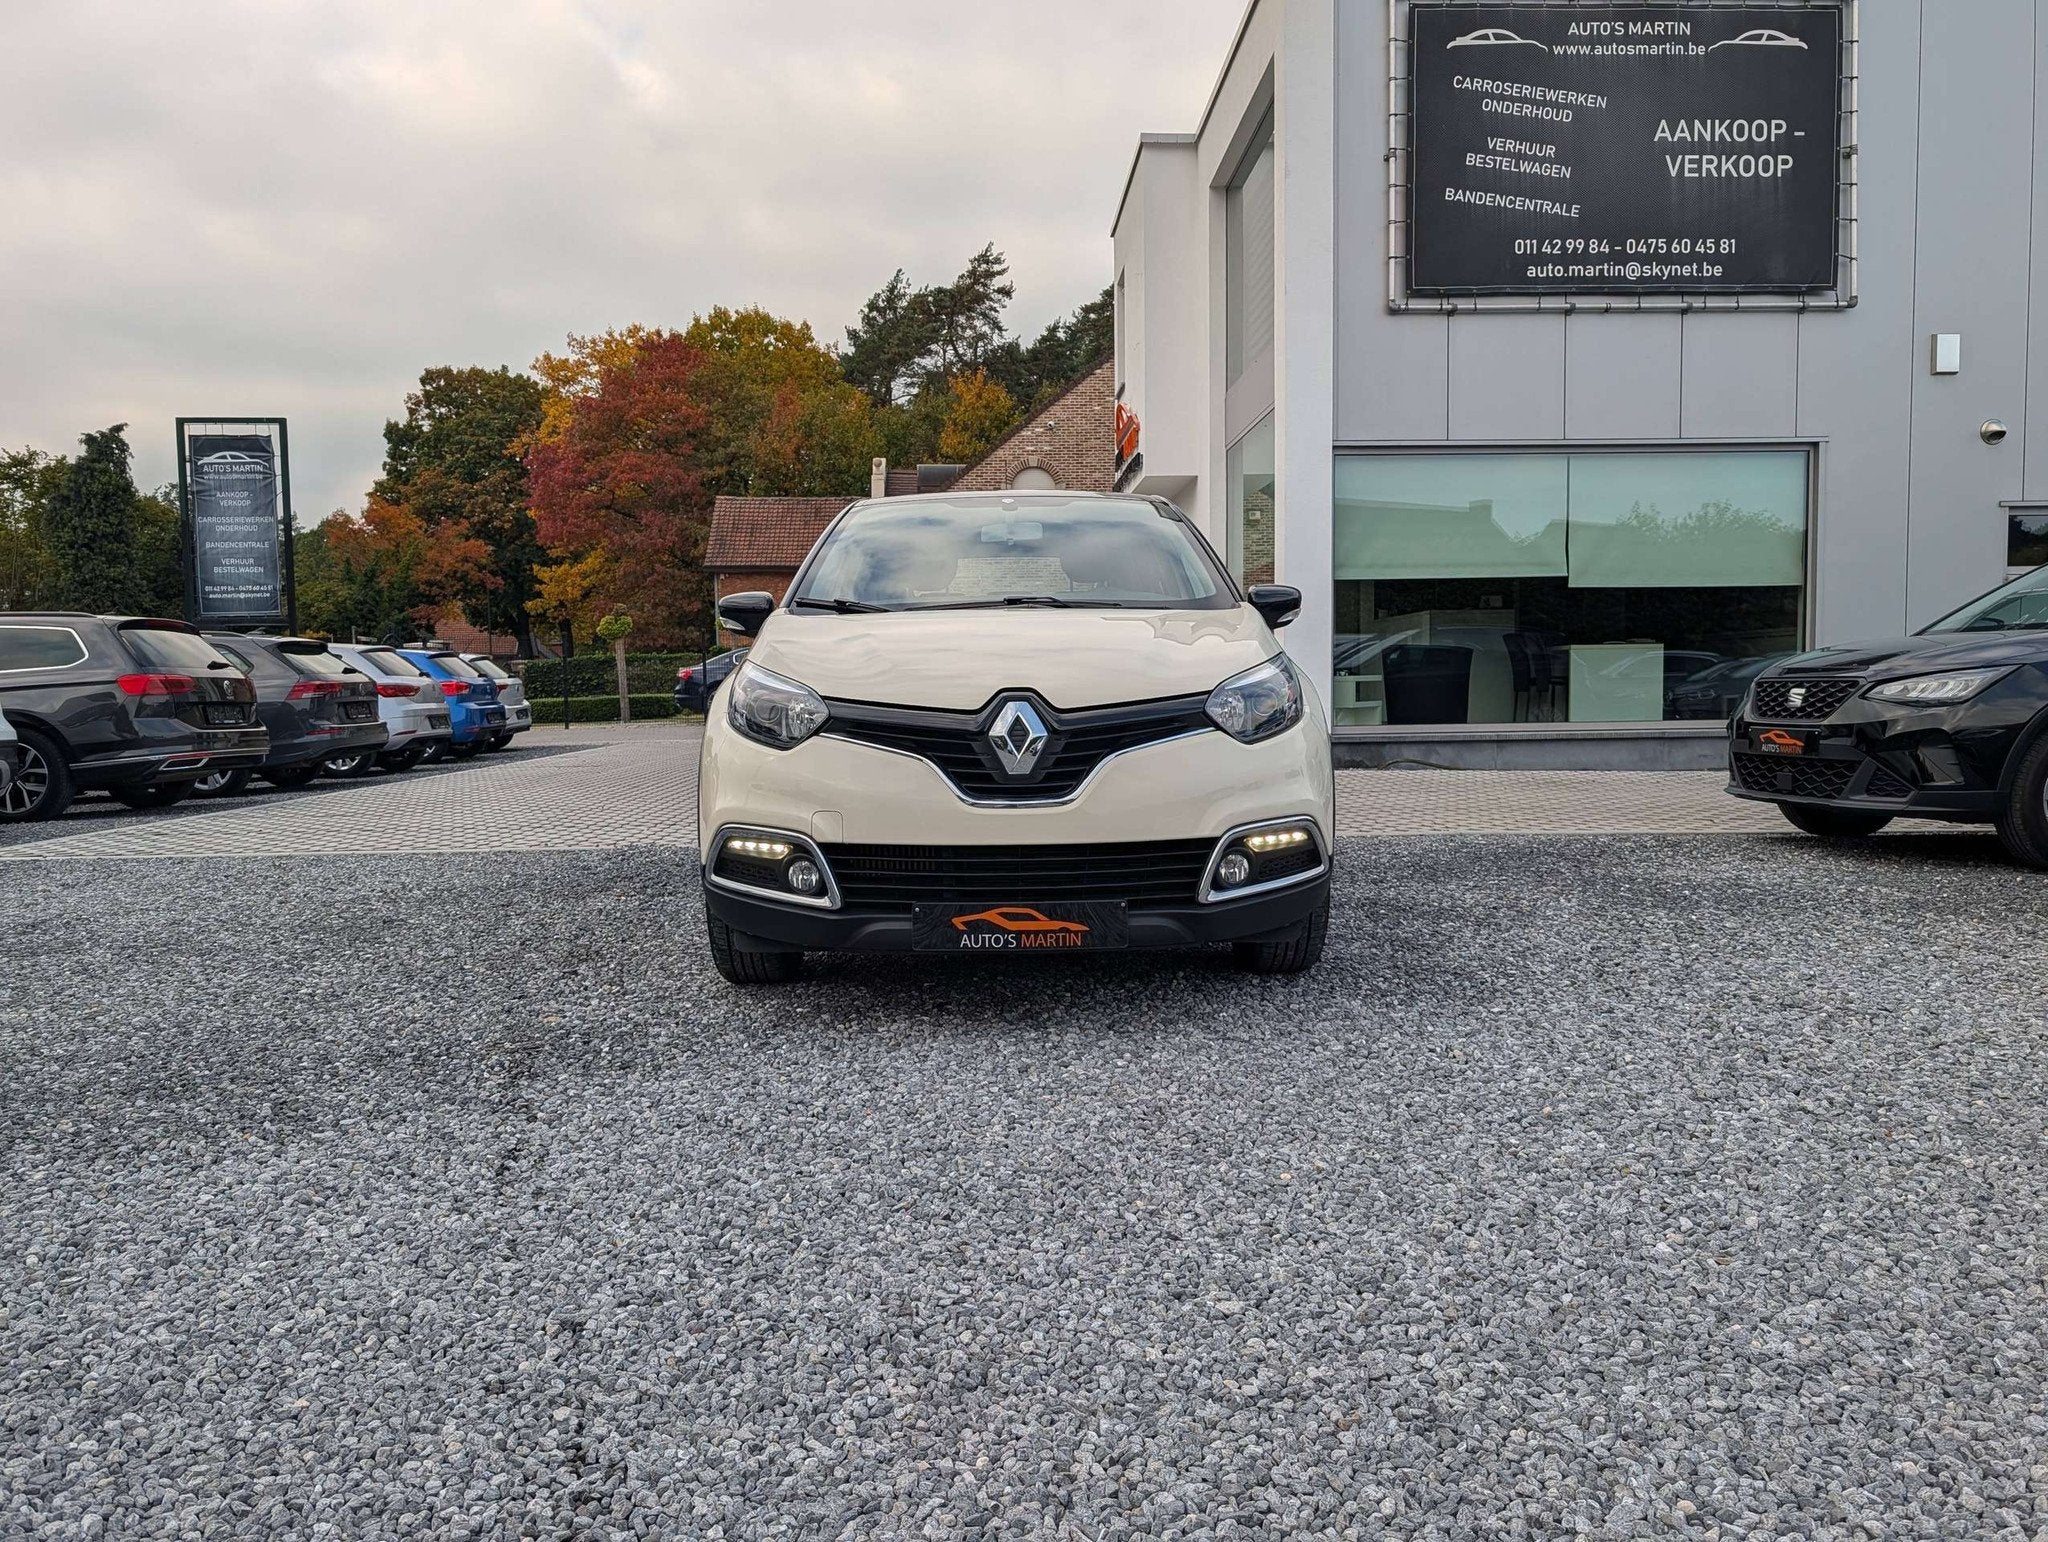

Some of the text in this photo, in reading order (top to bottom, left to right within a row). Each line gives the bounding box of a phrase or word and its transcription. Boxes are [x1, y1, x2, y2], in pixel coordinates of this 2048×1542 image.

[1567, 21, 1691, 36] AUTO'S MARTIN
[1552, 42, 1706, 55] www.autosmartin.be
[1453, 75, 1607, 108] CARROSERIEWERKEN
[1482, 98, 1573, 122] ONDERHOUD
[1653, 119, 1787, 142] AANKOOP
[1487, 136, 1556, 158] VERHUUR
[1465, 153, 1571, 179] BESTELWAGEN
[1665, 154, 1794, 177] VERKOOP
[1445, 187, 1581, 217] BANDENCENTRALE
[1514, 239, 1537, 254] 011
[1541, 239, 1562, 254] 42
[1566, 239, 1585, 254] 99
[1588, 239, 1609, 254] 84
[1626, 239, 1667, 254] 0475
[1671, 239, 1691, 254] 60
[1695, 239, 1715, 254] 45
[1719, 239, 1736, 254] 81
[1526, 262, 1723, 280] auto.martin@skynet.be
[203, 464, 264, 472] AUTO'S MARTIN
[960, 932, 1082, 948] AUTO'S MARTIN
